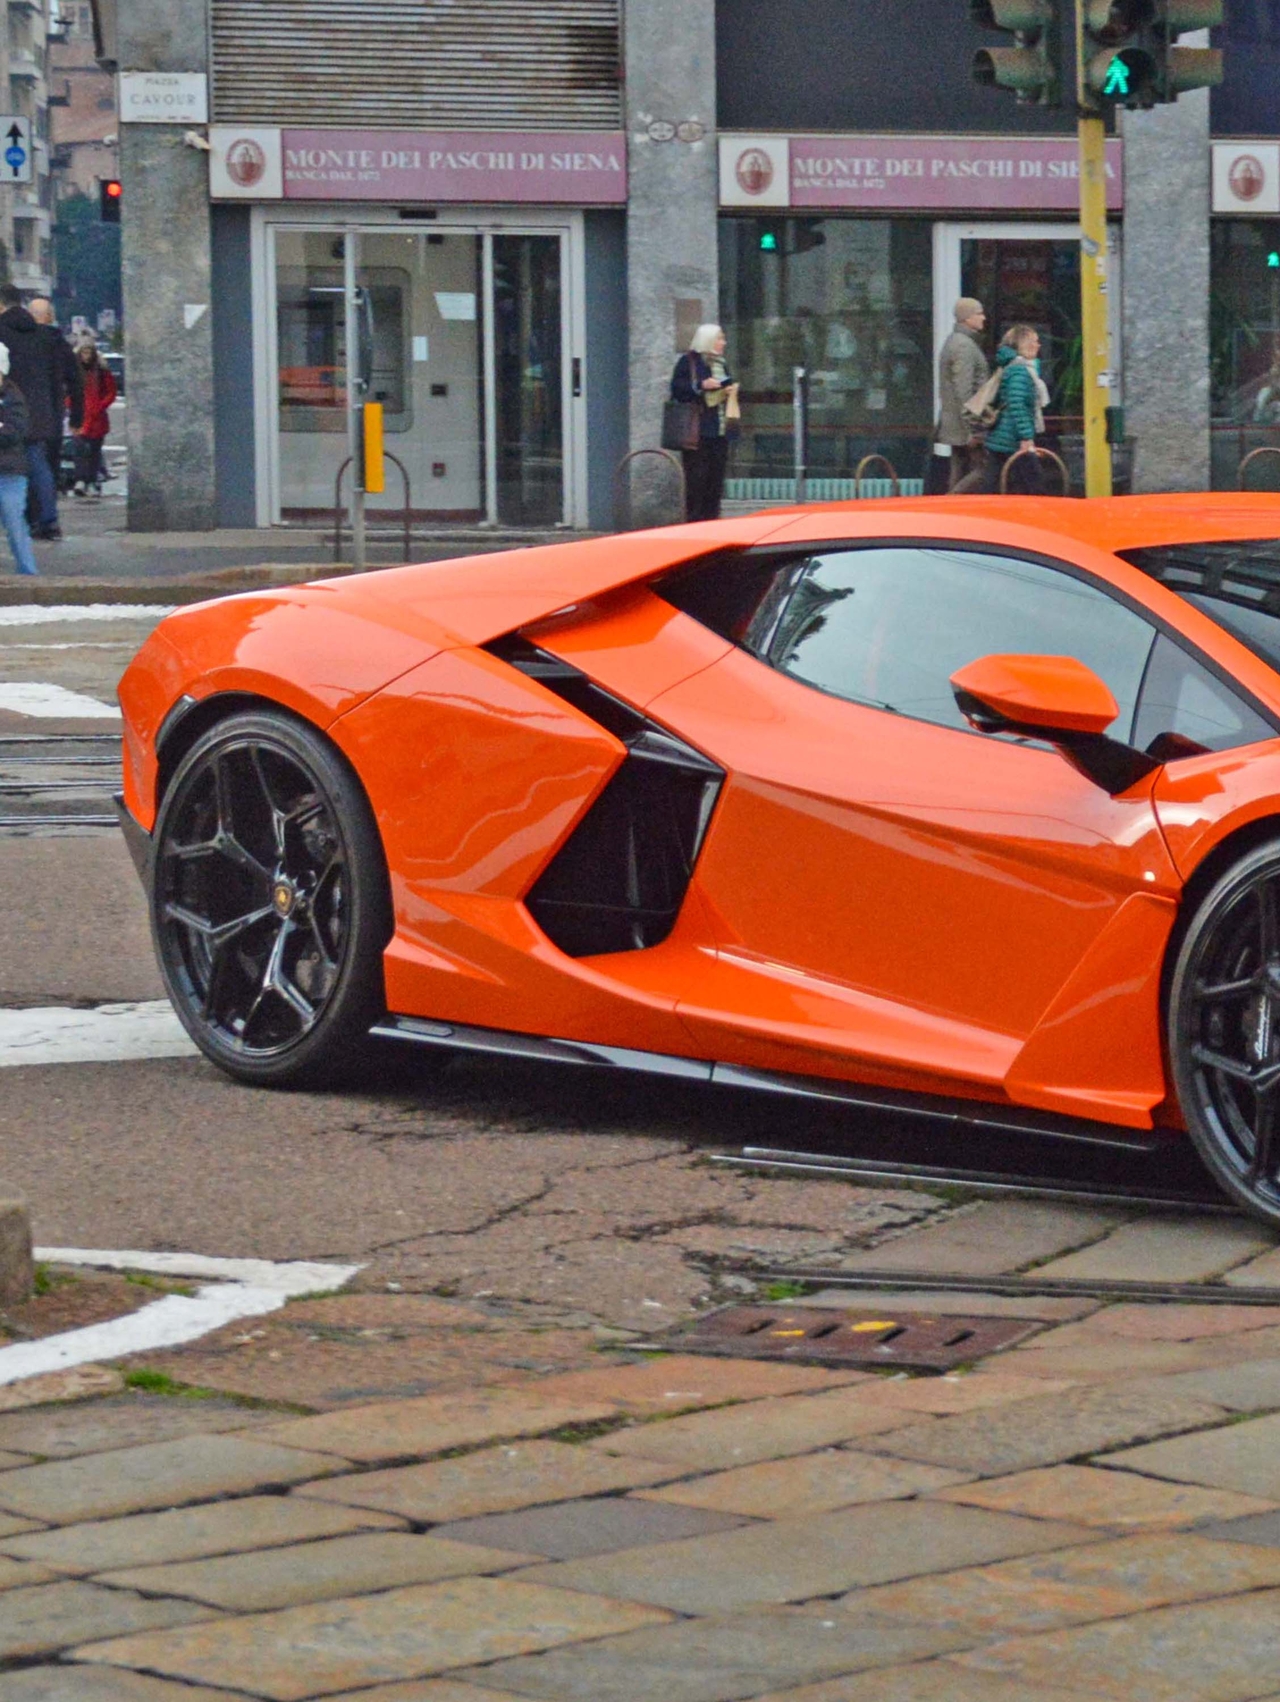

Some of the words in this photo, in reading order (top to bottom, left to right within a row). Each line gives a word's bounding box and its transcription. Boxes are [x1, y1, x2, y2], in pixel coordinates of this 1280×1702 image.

[130, 93, 196, 106] CAVOUR
[285, 149, 375, 168] MONTE
[381, 151, 421, 169] DEI
[428, 151, 515, 170] PASCHI
[520, 152, 545, 170] DI
[551, 152, 621, 171] SIENA
[794, 157, 881, 176] MONTE
[885, 158, 924, 176] DEI
[931, 159, 1013, 178] PASCHI
[1018, 160, 1042, 177] DI
[1048, 159, 1115, 178] SIEA
